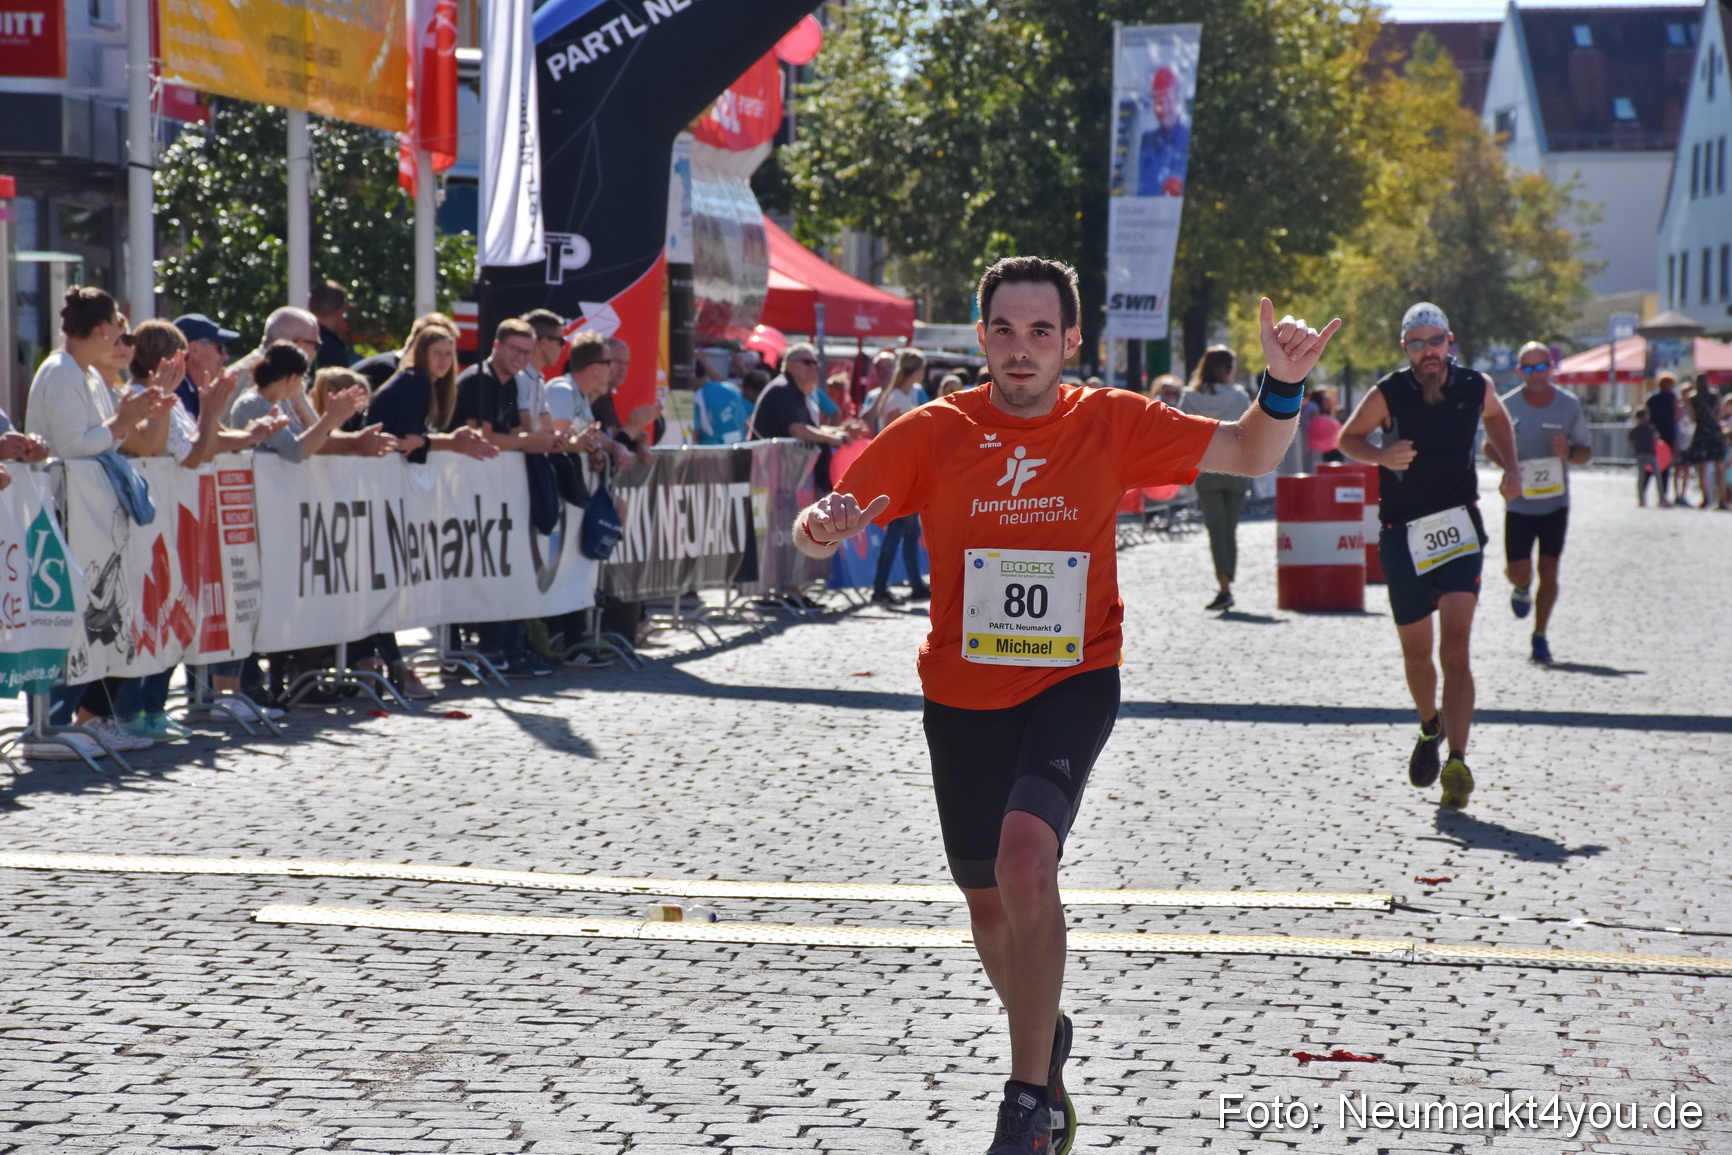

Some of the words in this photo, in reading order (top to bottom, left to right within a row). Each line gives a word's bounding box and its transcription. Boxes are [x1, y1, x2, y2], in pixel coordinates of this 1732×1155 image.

[0, 12, 46, 36] ITT
[545, 13, 648, 82] PARTL
[1534, 470, 1550, 482] 22
[970, 496, 1065, 517] funrunners
[999, 507, 1079, 525] neumarkt
[299, 501, 387, 597] PARTL
[1424, 526, 1461, 551] 309
[1001, 561, 1054, 574] BOCK
[1004, 583, 1048, 618] 80
[989, 622, 1014, 630] PARTL
[1016, 623, 1051, 632] Neumarkt
[996, 638, 1052, 655] Michael
